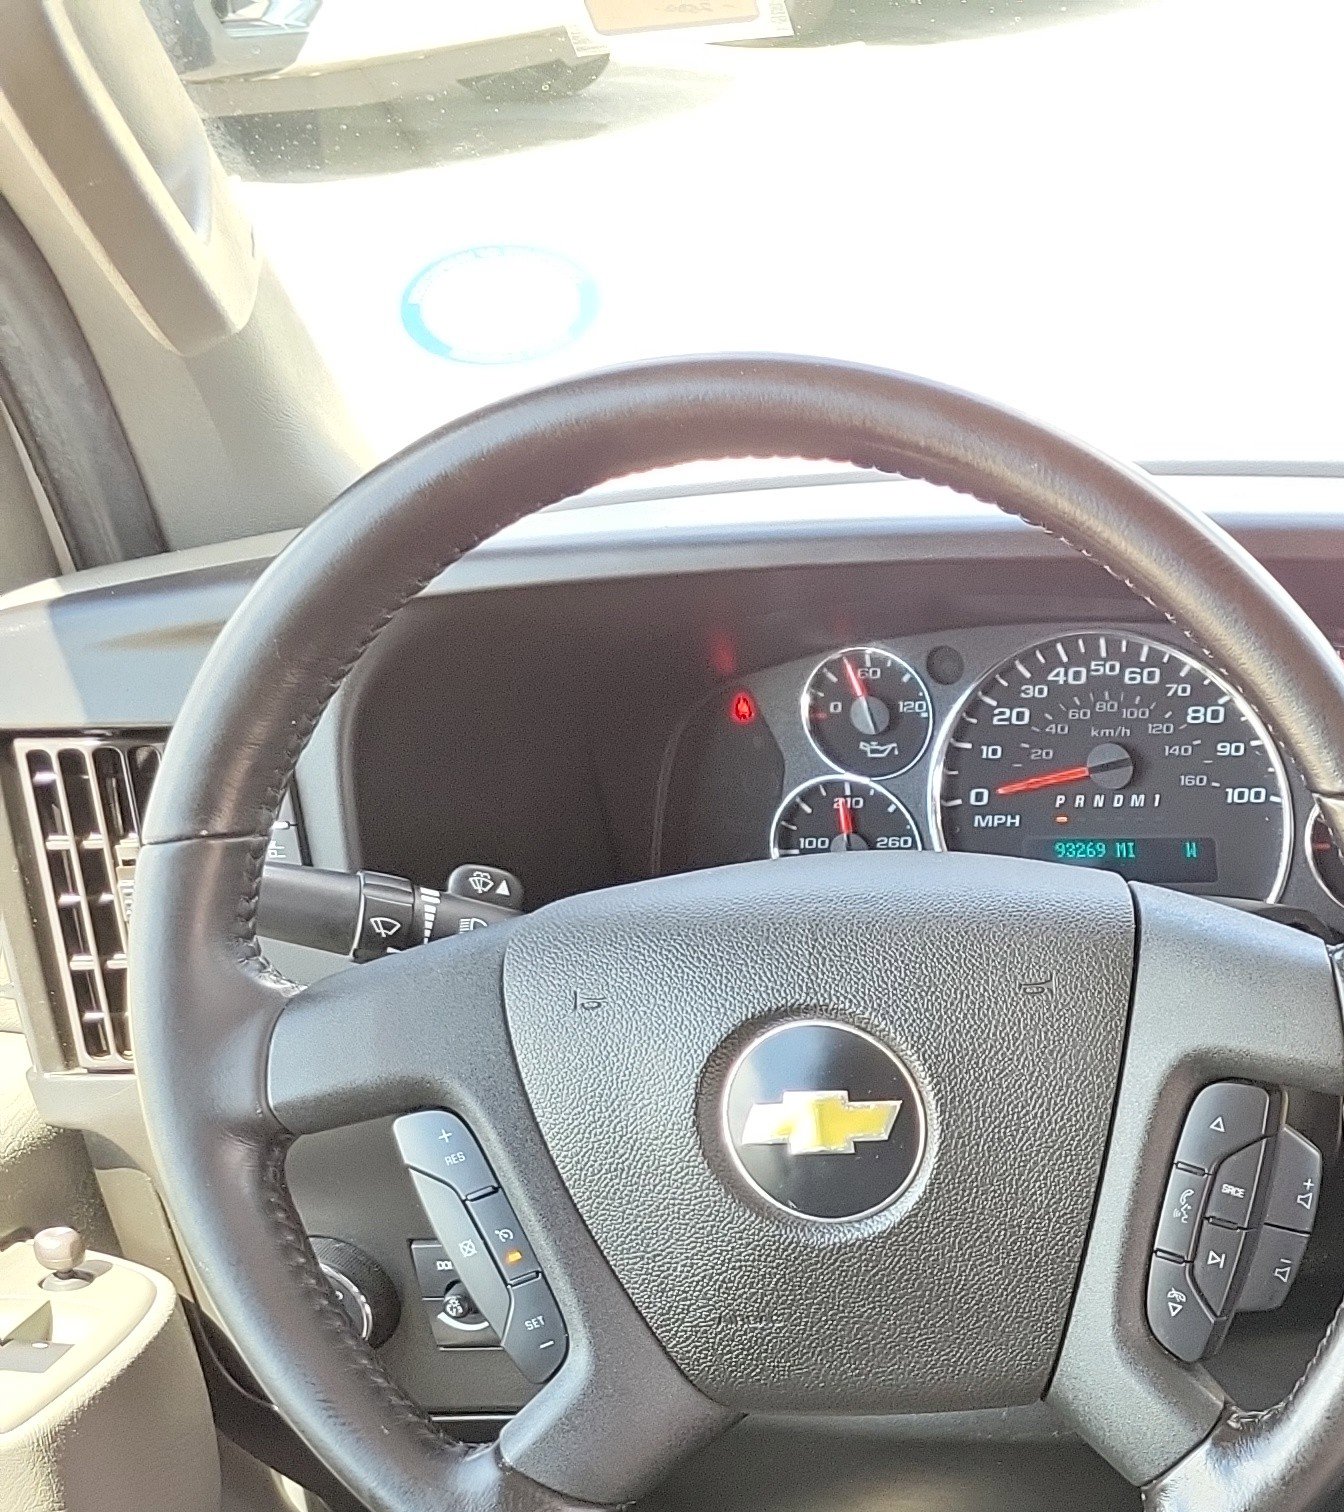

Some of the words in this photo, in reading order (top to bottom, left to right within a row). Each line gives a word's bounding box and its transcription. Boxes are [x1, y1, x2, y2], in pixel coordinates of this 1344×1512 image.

[857, 668, 881, 679] 60
[1090, 661, 1120, 676] 50
[1047, 667, 1087, 685] 40
[1124, 667, 1160, 685] 60
[1020, 685, 1048, 698] 30
[1165, 684, 1191, 697] 70
[829, 701, 842, 713] 0
[899, 701, 927, 712] 120
[1095, 701, 1118, 712] 80
[992, 708, 1031, 725] 20
[1068, 709, 1091, 720] 60
[1121, 708, 1149, 719] 100
[1186, 706, 1225, 724] 80
[1045, 724, 1069, 734] 40
[1091, 727, 1131, 737] km/h
[1148, 723, 1174, 734] 120
[981, 746, 1002, 759] 10
[1030, 749, 1053, 760] 20
[1164, 745, 1192, 756] 140
[1216, 742, 1245, 756] 90
[1179, 775, 1207, 787] 160
[969, 788, 989, 806] 0
[1225, 787, 1266, 803] 100
[833, 798, 864, 809] 210
[974, 815, 1020, 827] MPH
[799, 838, 829, 849] 100
[876, 837, 912, 848] 260
[1055, 842, 1106, 858] 93269
[1115, 842, 1136, 858] MI
[444, 1151, 466, 1166] RES
[524, 1316, 545, 1331] SET
